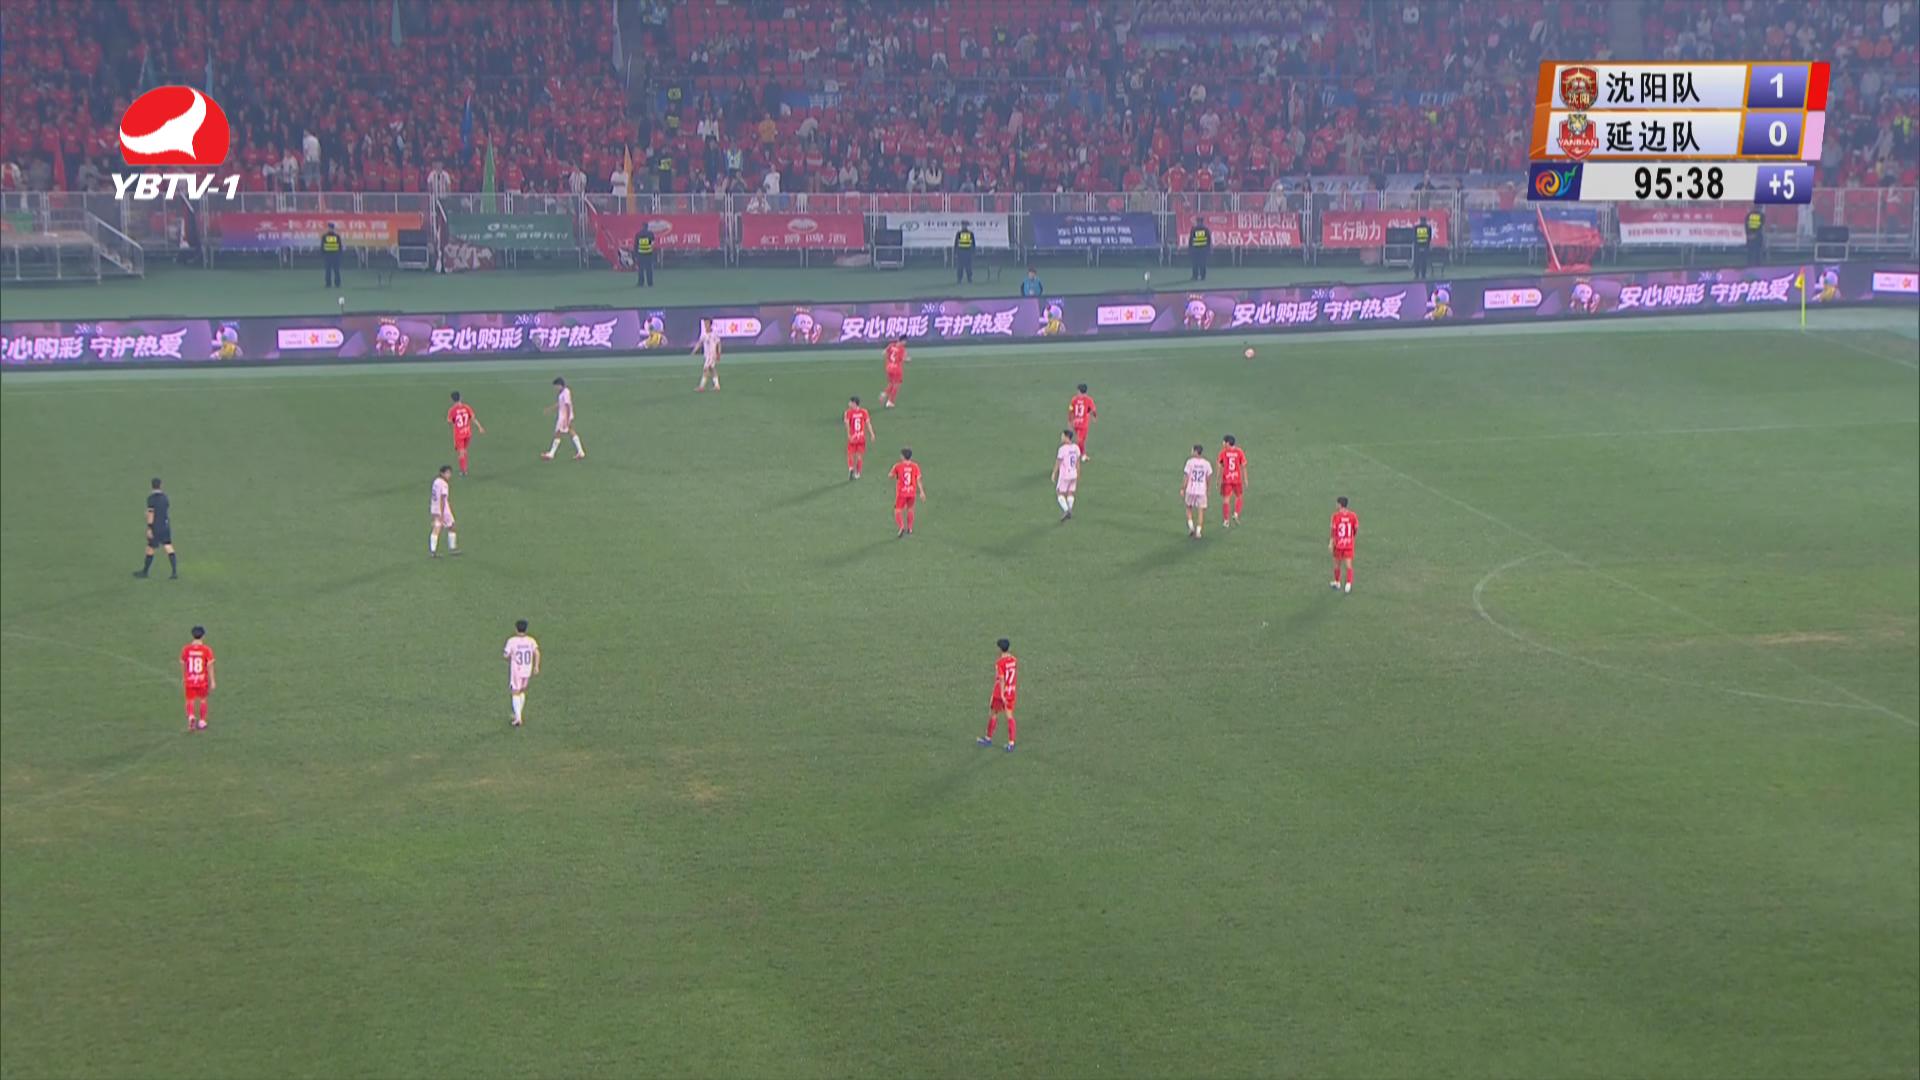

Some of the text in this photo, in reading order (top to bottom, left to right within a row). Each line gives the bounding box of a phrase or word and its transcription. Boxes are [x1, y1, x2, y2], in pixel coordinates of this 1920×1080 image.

[1329, 220, 1382, 241] 工行助力
[1617, 273, 1794, 309] 安心购彩 守护热爱
[1231, 291, 1407, 328] 安心购彩 守护热爱
[839, 306, 1019, 343] 安心购彩 守护热爱
[1, 336, 83, 360] 心购彩
[89, 327, 187, 359] 守护热爱
[428, 318, 618, 353] 安心购彩 守护热爱
[1074, 404, 1085, 417] 13
[455, 412, 469, 428] 37
[854, 418, 861, 431] 6
[1228, 458, 1236, 471] 5
[903, 472, 911, 485] 3
[1191, 470, 1204, 483] 32
[1338, 522, 1352, 537] 31
[188, 656, 203, 673] 18
[515, 650, 531, 665] 30
[1004, 668, 1016, 685] 17
